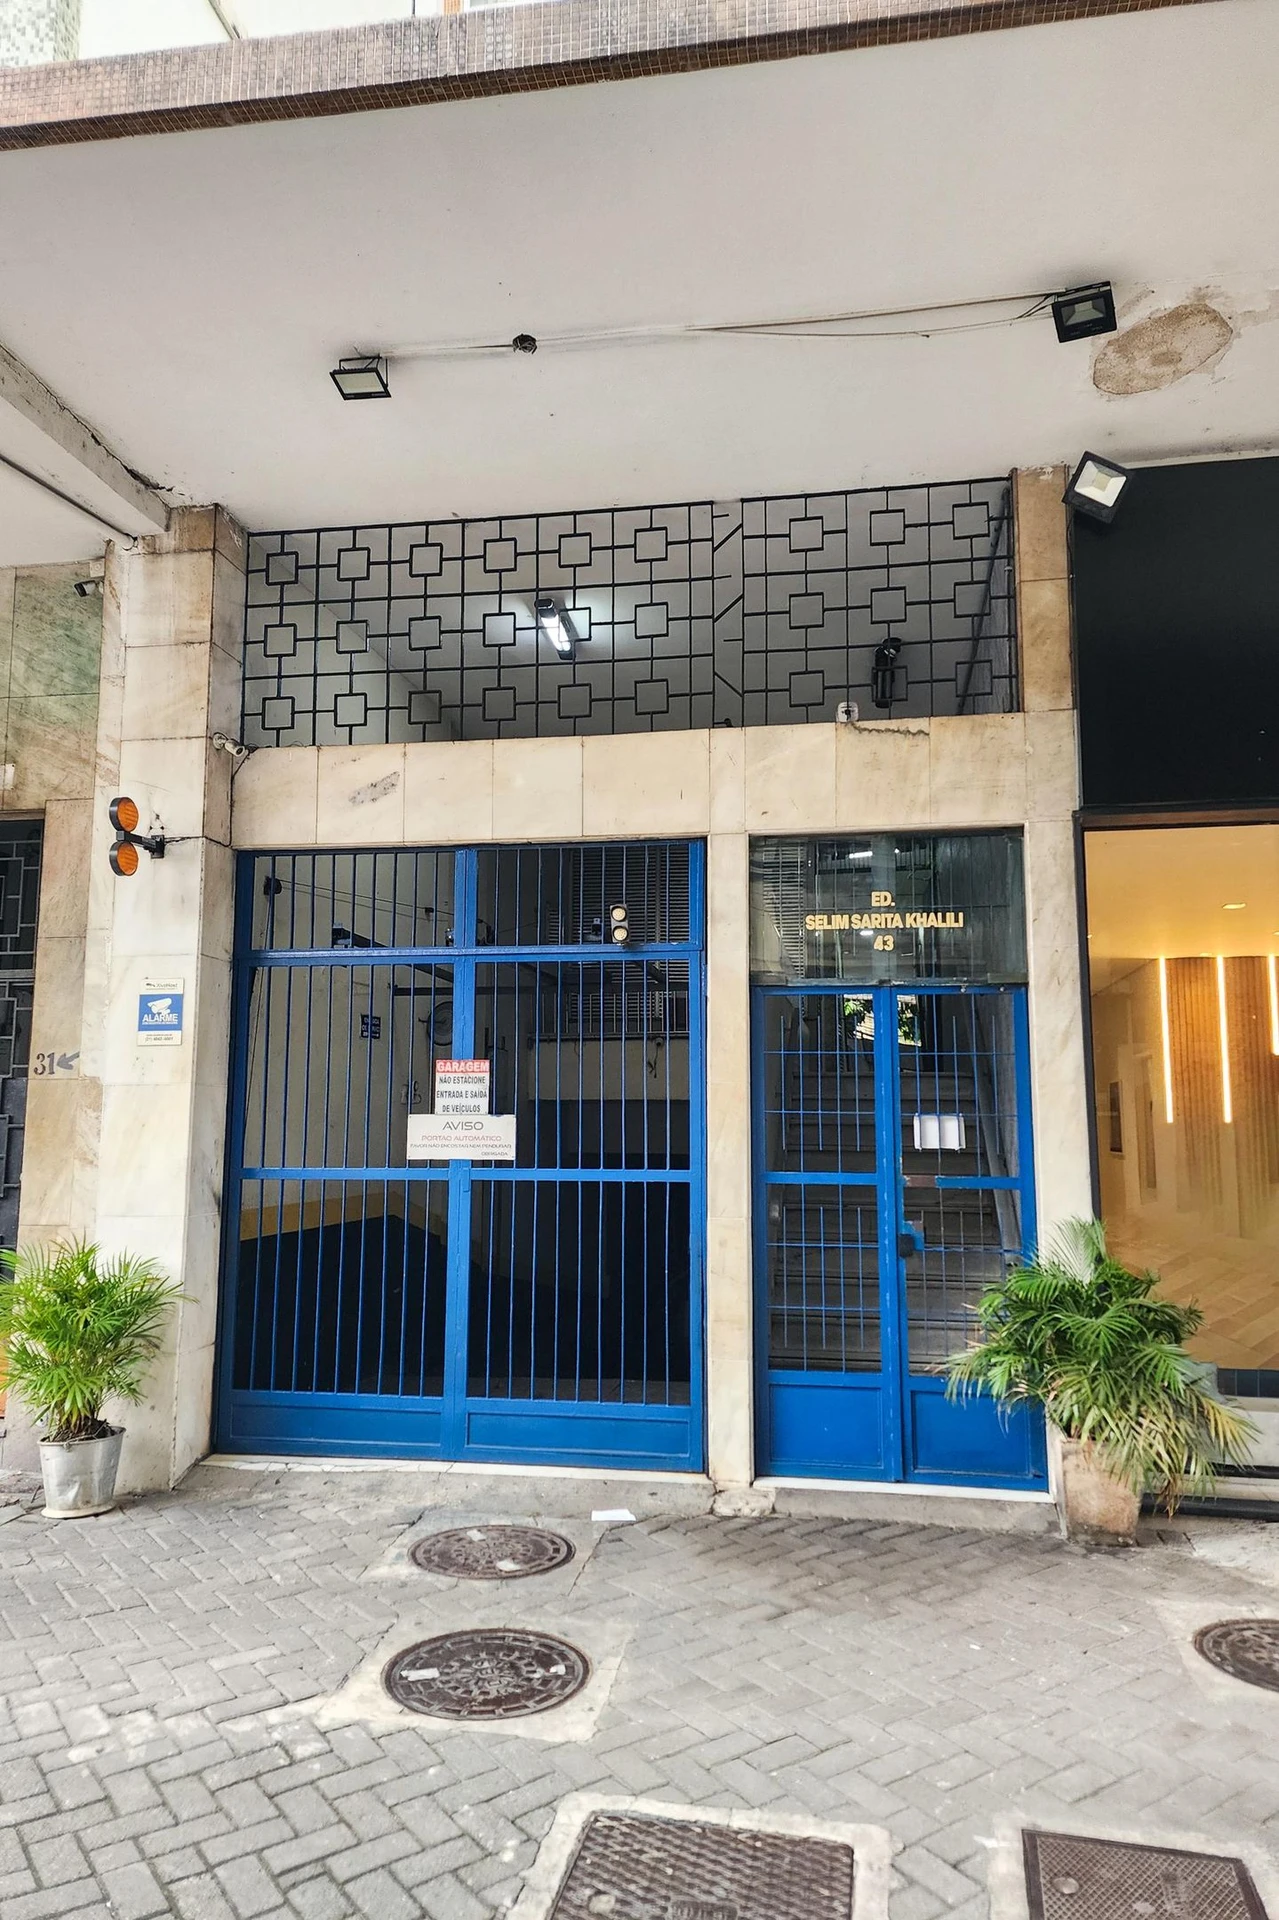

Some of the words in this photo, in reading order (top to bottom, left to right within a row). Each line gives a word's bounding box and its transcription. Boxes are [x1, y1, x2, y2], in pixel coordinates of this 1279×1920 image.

[871, 892, 895, 907] ED.
[805, 915, 849, 930] SELIM
[851, 914, 903, 929] SARITA
[906, 912, 964, 928] KHALILI
[874, 935, 894, 951] 43
[142, 1013, 178, 1022] ALARME
[33, 1052, 55, 1075] 31
[437, 1061, 489, 1072] GARAGEM
[439, 1074, 451, 1084] NÃO
[453, 1076, 486, 1084] ESTACIONE
[436, 1090, 463, 1099] ENTRADA
[465, 1090, 469, 1099] E
[470, 1088, 487, 1098] SAÍDA
[442, 1104, 449, 1113] DE
[452, 1103, 481, 1113] VEÍCULOS
[442, 1121, 484, 1131] AVISO
